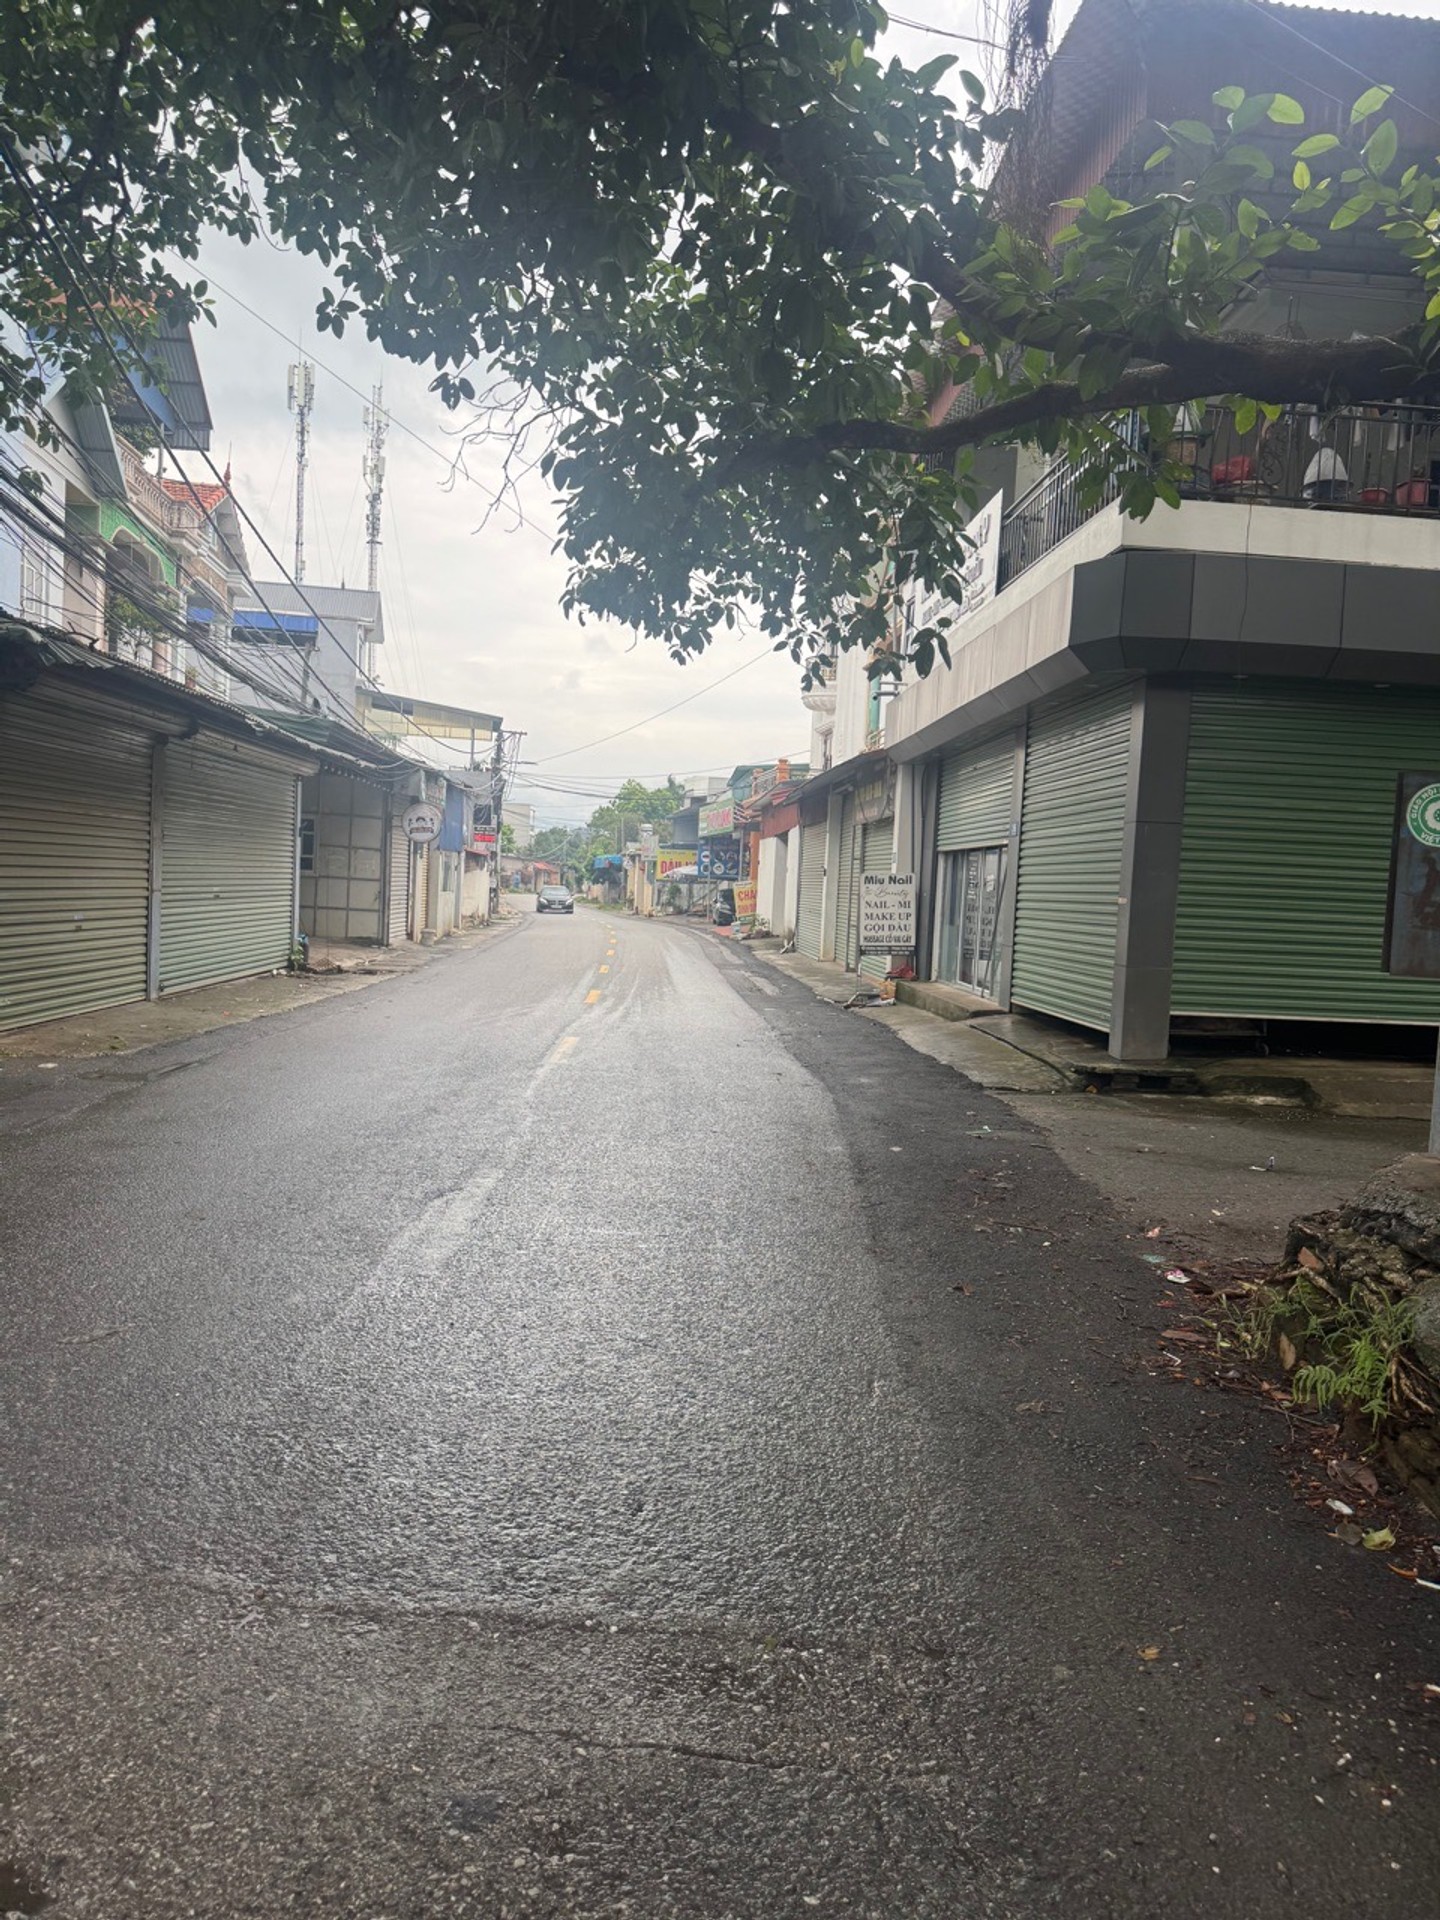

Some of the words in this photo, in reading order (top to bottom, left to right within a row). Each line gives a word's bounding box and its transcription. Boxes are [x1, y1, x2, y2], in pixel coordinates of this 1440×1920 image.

[864, 875, 885, 885] Miu
[888, 875, 912, 885] Nail
[865, 900, 890, 909] NAIL
[864, 912, 896, 921] MAKE
[898, 912, 912, 921] UP
